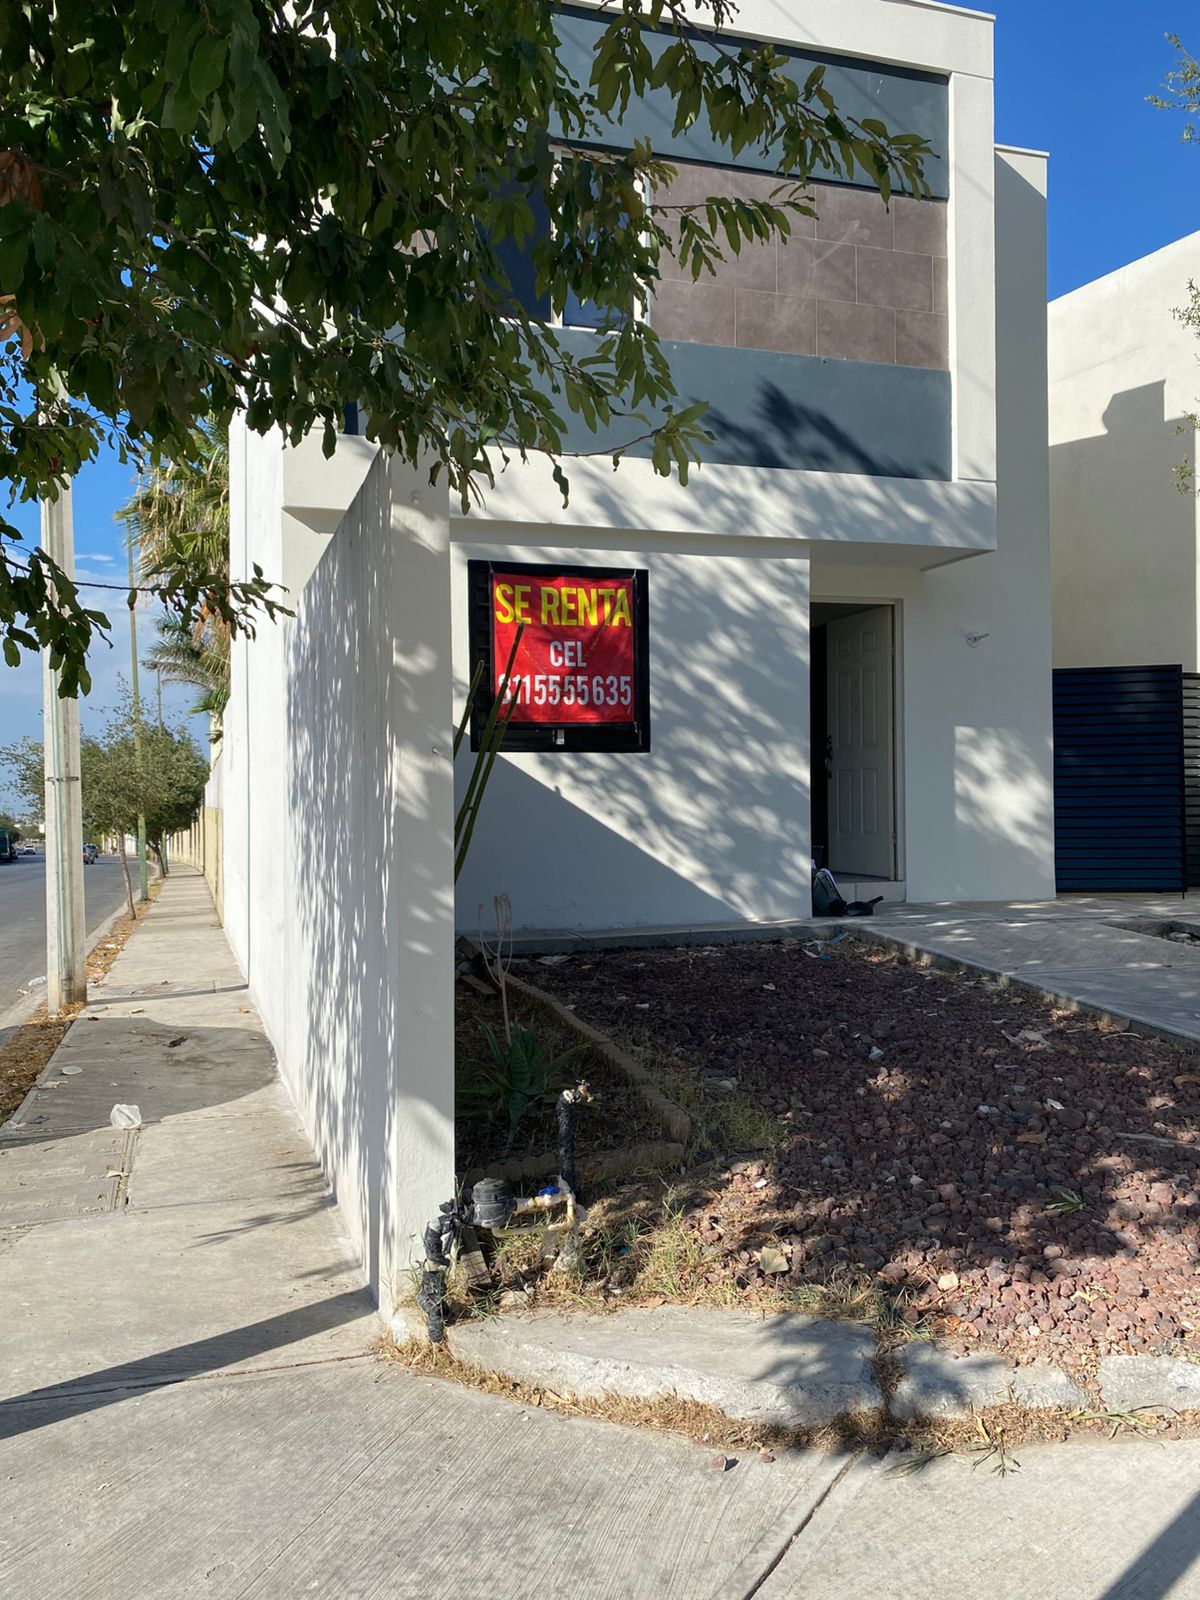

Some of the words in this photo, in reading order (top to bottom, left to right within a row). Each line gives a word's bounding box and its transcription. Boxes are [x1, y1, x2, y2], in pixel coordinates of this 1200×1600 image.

[495, 583, 532, 625] SE
[541, 586, 632, 627] RENTA
[549, 641, 587, 667] CEL
